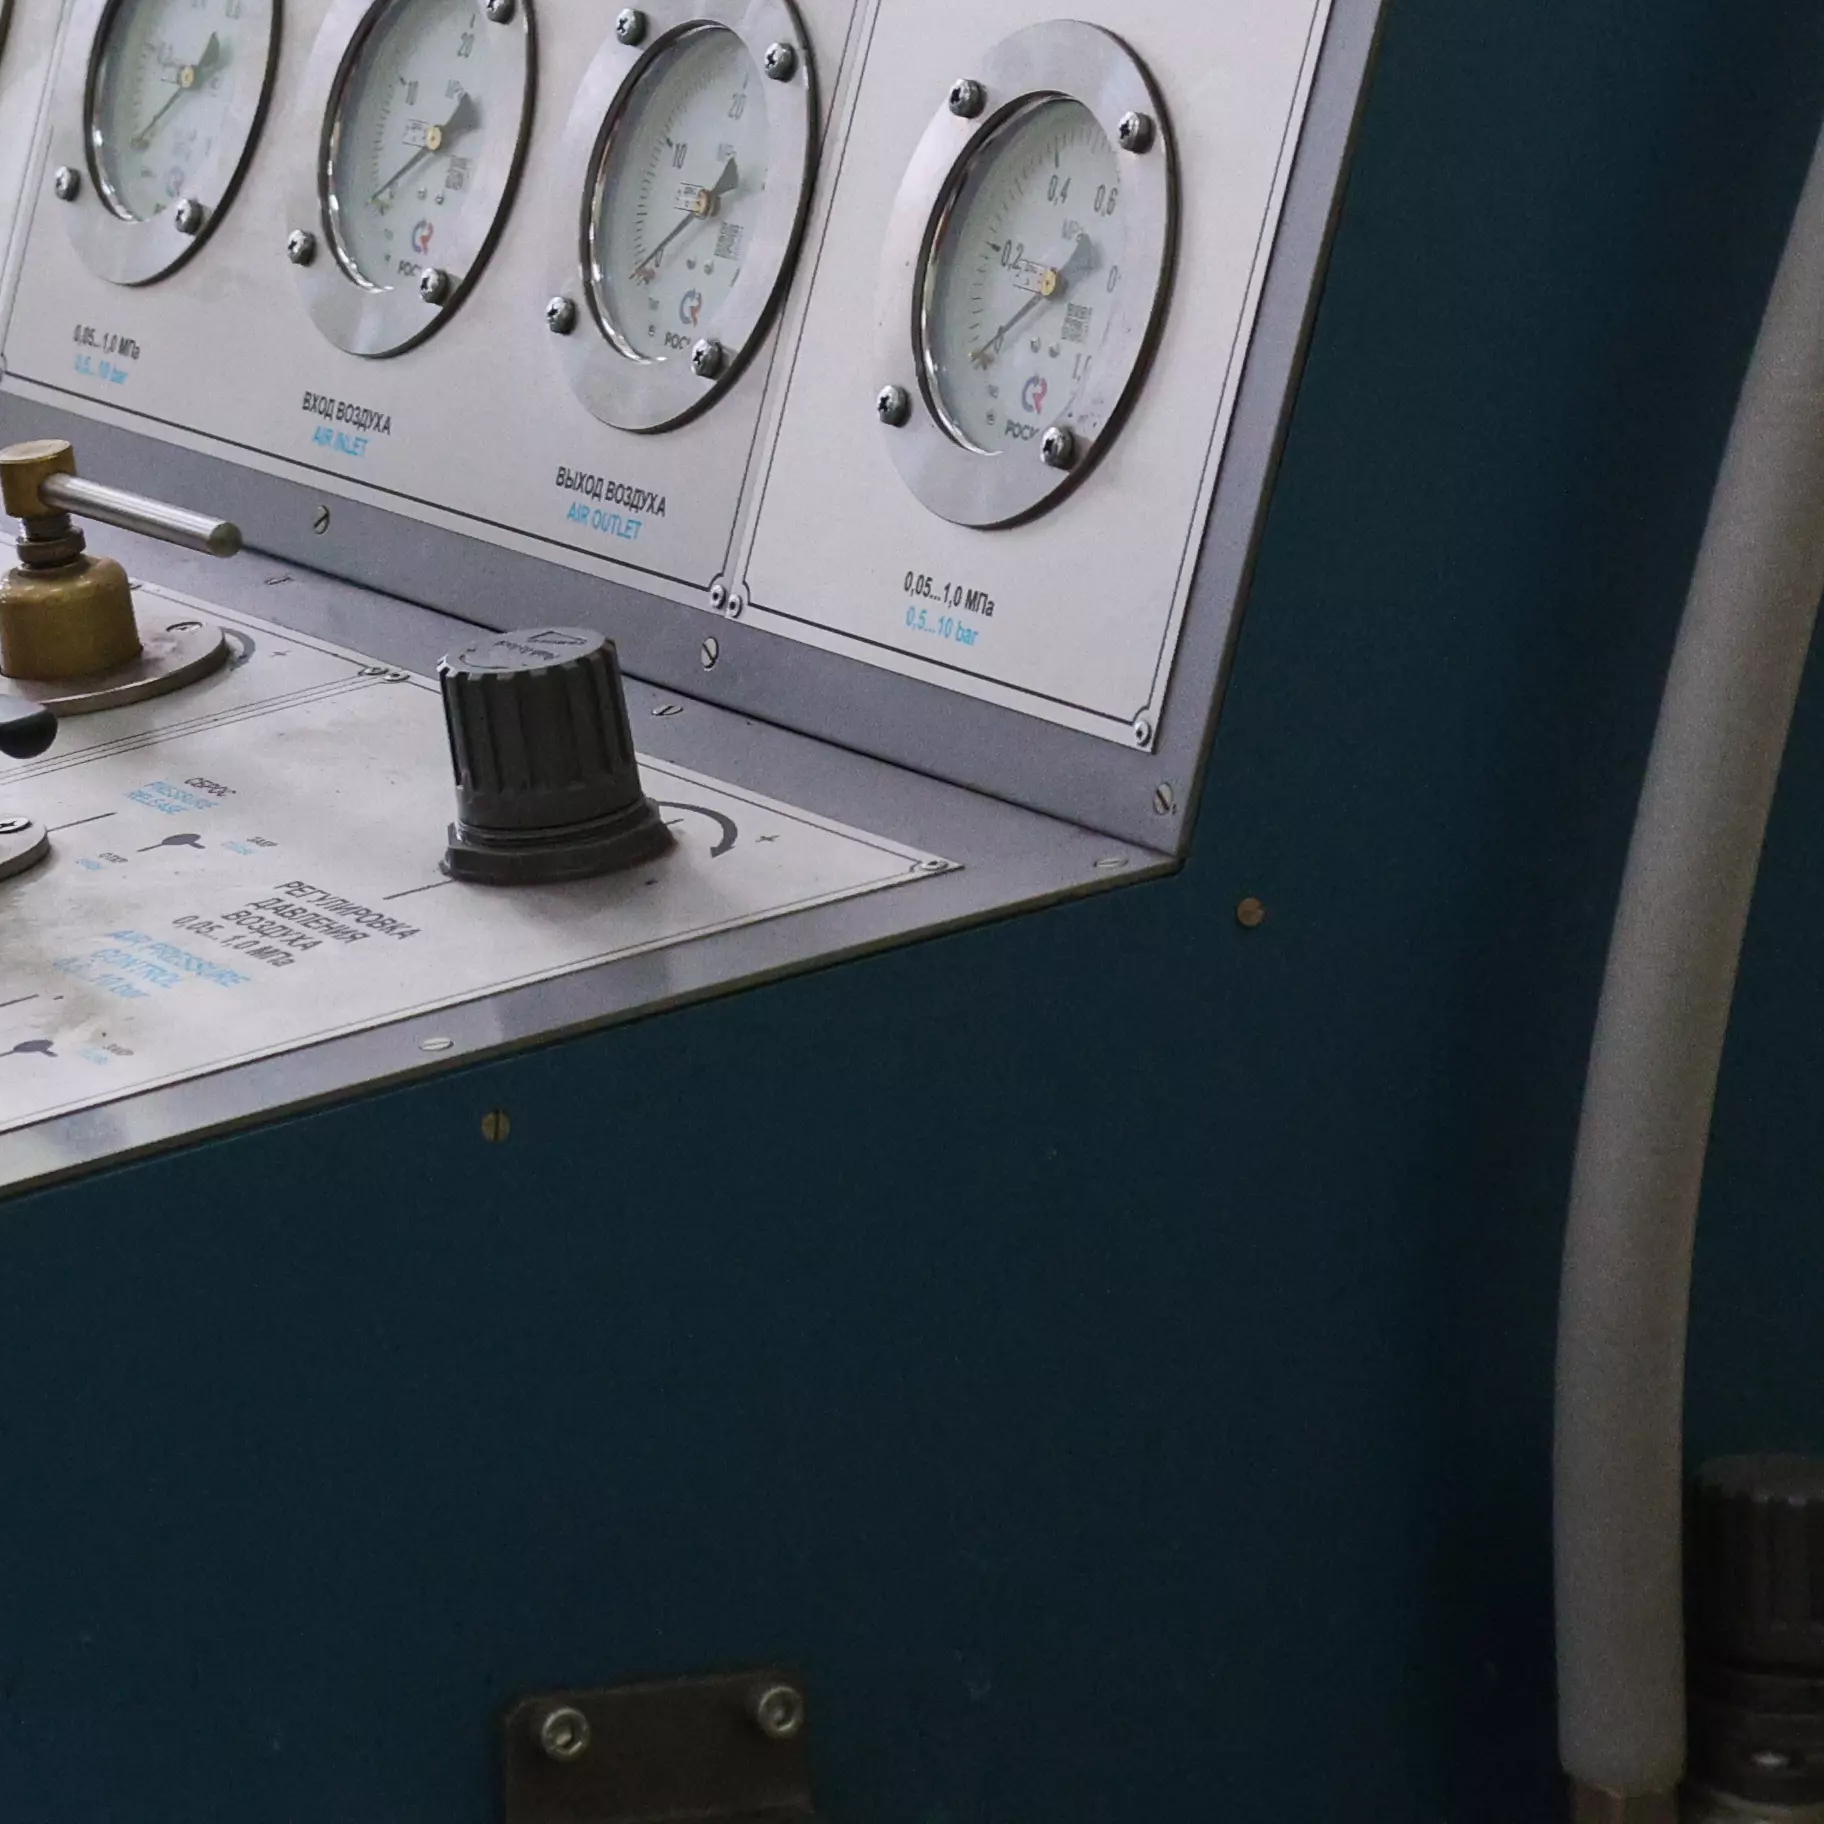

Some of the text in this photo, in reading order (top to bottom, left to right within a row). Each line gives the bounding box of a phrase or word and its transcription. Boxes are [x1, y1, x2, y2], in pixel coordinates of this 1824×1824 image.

[727, 92, 747, 121] 20
[672, 142, 688, 170] 10
[1047, 174, 1072, 206] 0,4
[1093, 184, 1119, 216] 0,6
[302, 390, 392, 436] ВХОД ВОЗДУХА
[555, 465, 667, 518] ВЫХОД ВОЗДУХА
[566, 501, 643, 540] AIR OUTLET
[904, 570, 995, 618] 0,05...1,0 МПа
[905, 605, 979, 646] 0,5...10 bar
[220, 909, 324, 952] ВОЗДУХА
[243, 896, 372, 945] ДАВЛЕНИЯ
[272, 880, 422, 941] РЕГУЛИРОВКА
